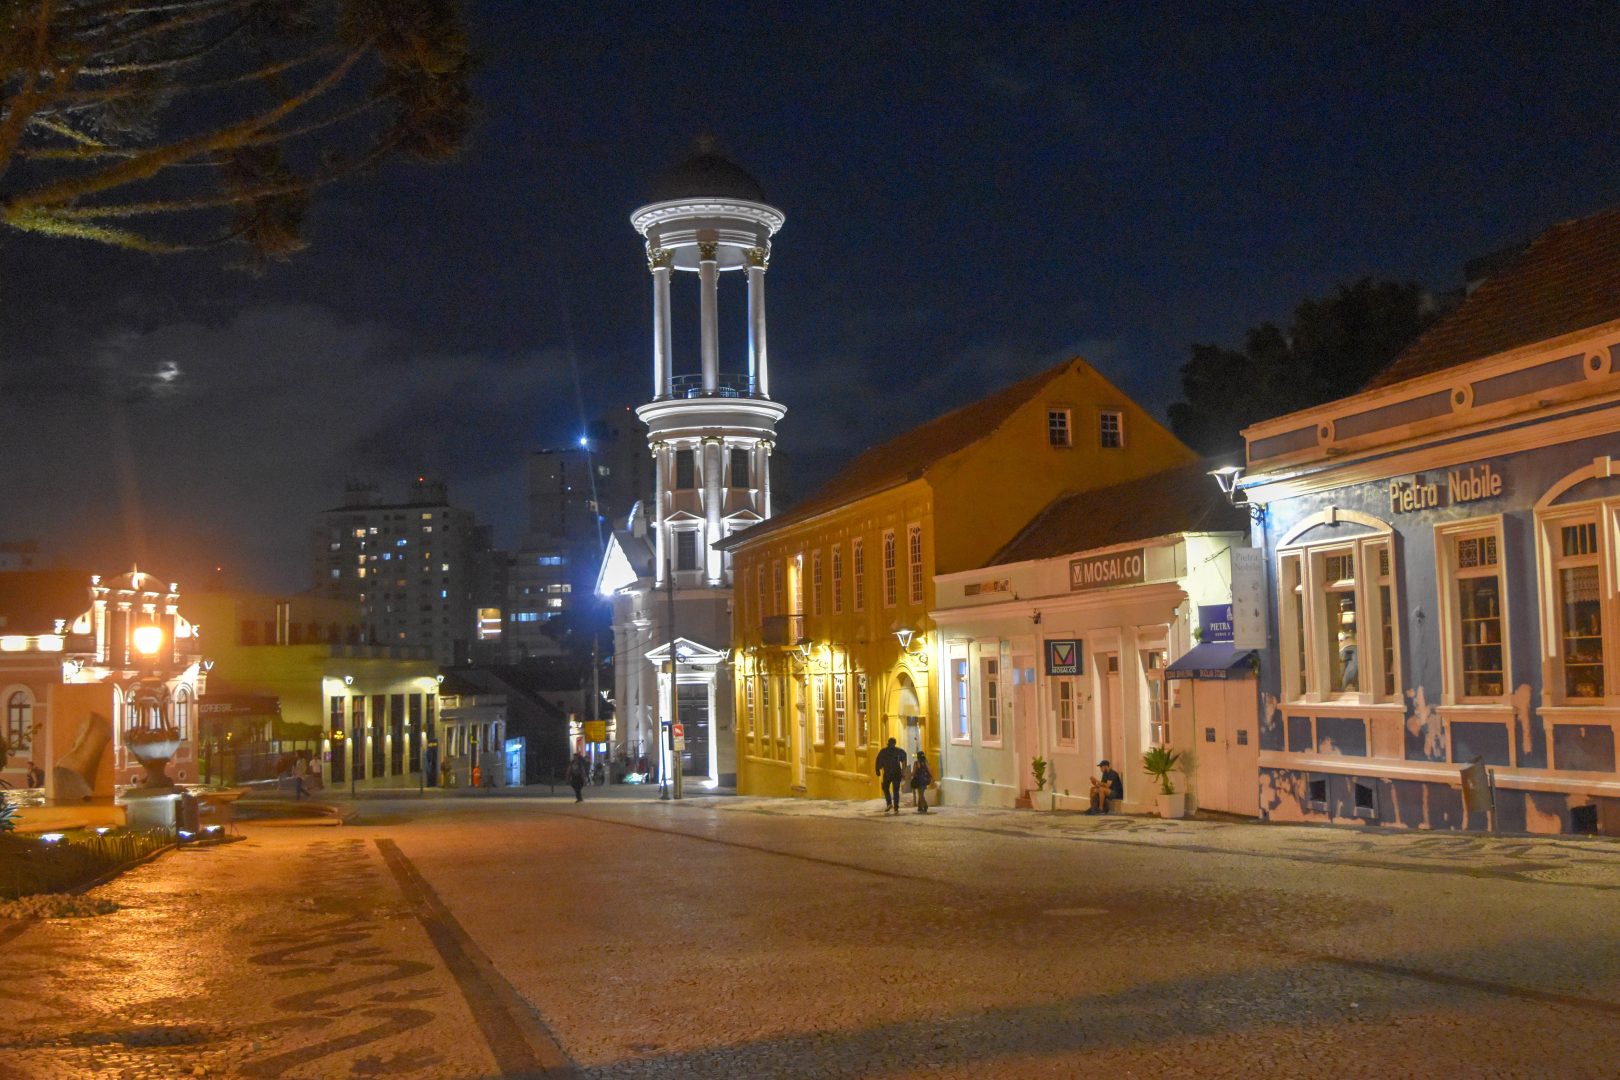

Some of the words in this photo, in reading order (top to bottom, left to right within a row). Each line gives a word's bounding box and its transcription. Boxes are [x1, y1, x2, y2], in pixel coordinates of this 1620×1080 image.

[1388, 474, 1438, 513] Pietra
[1447, 464, 1502, 506] Nobile
[1083, 555, 1141, 583] MOSAI.CO
[1210, 622, 1231, 631] PIETRA
